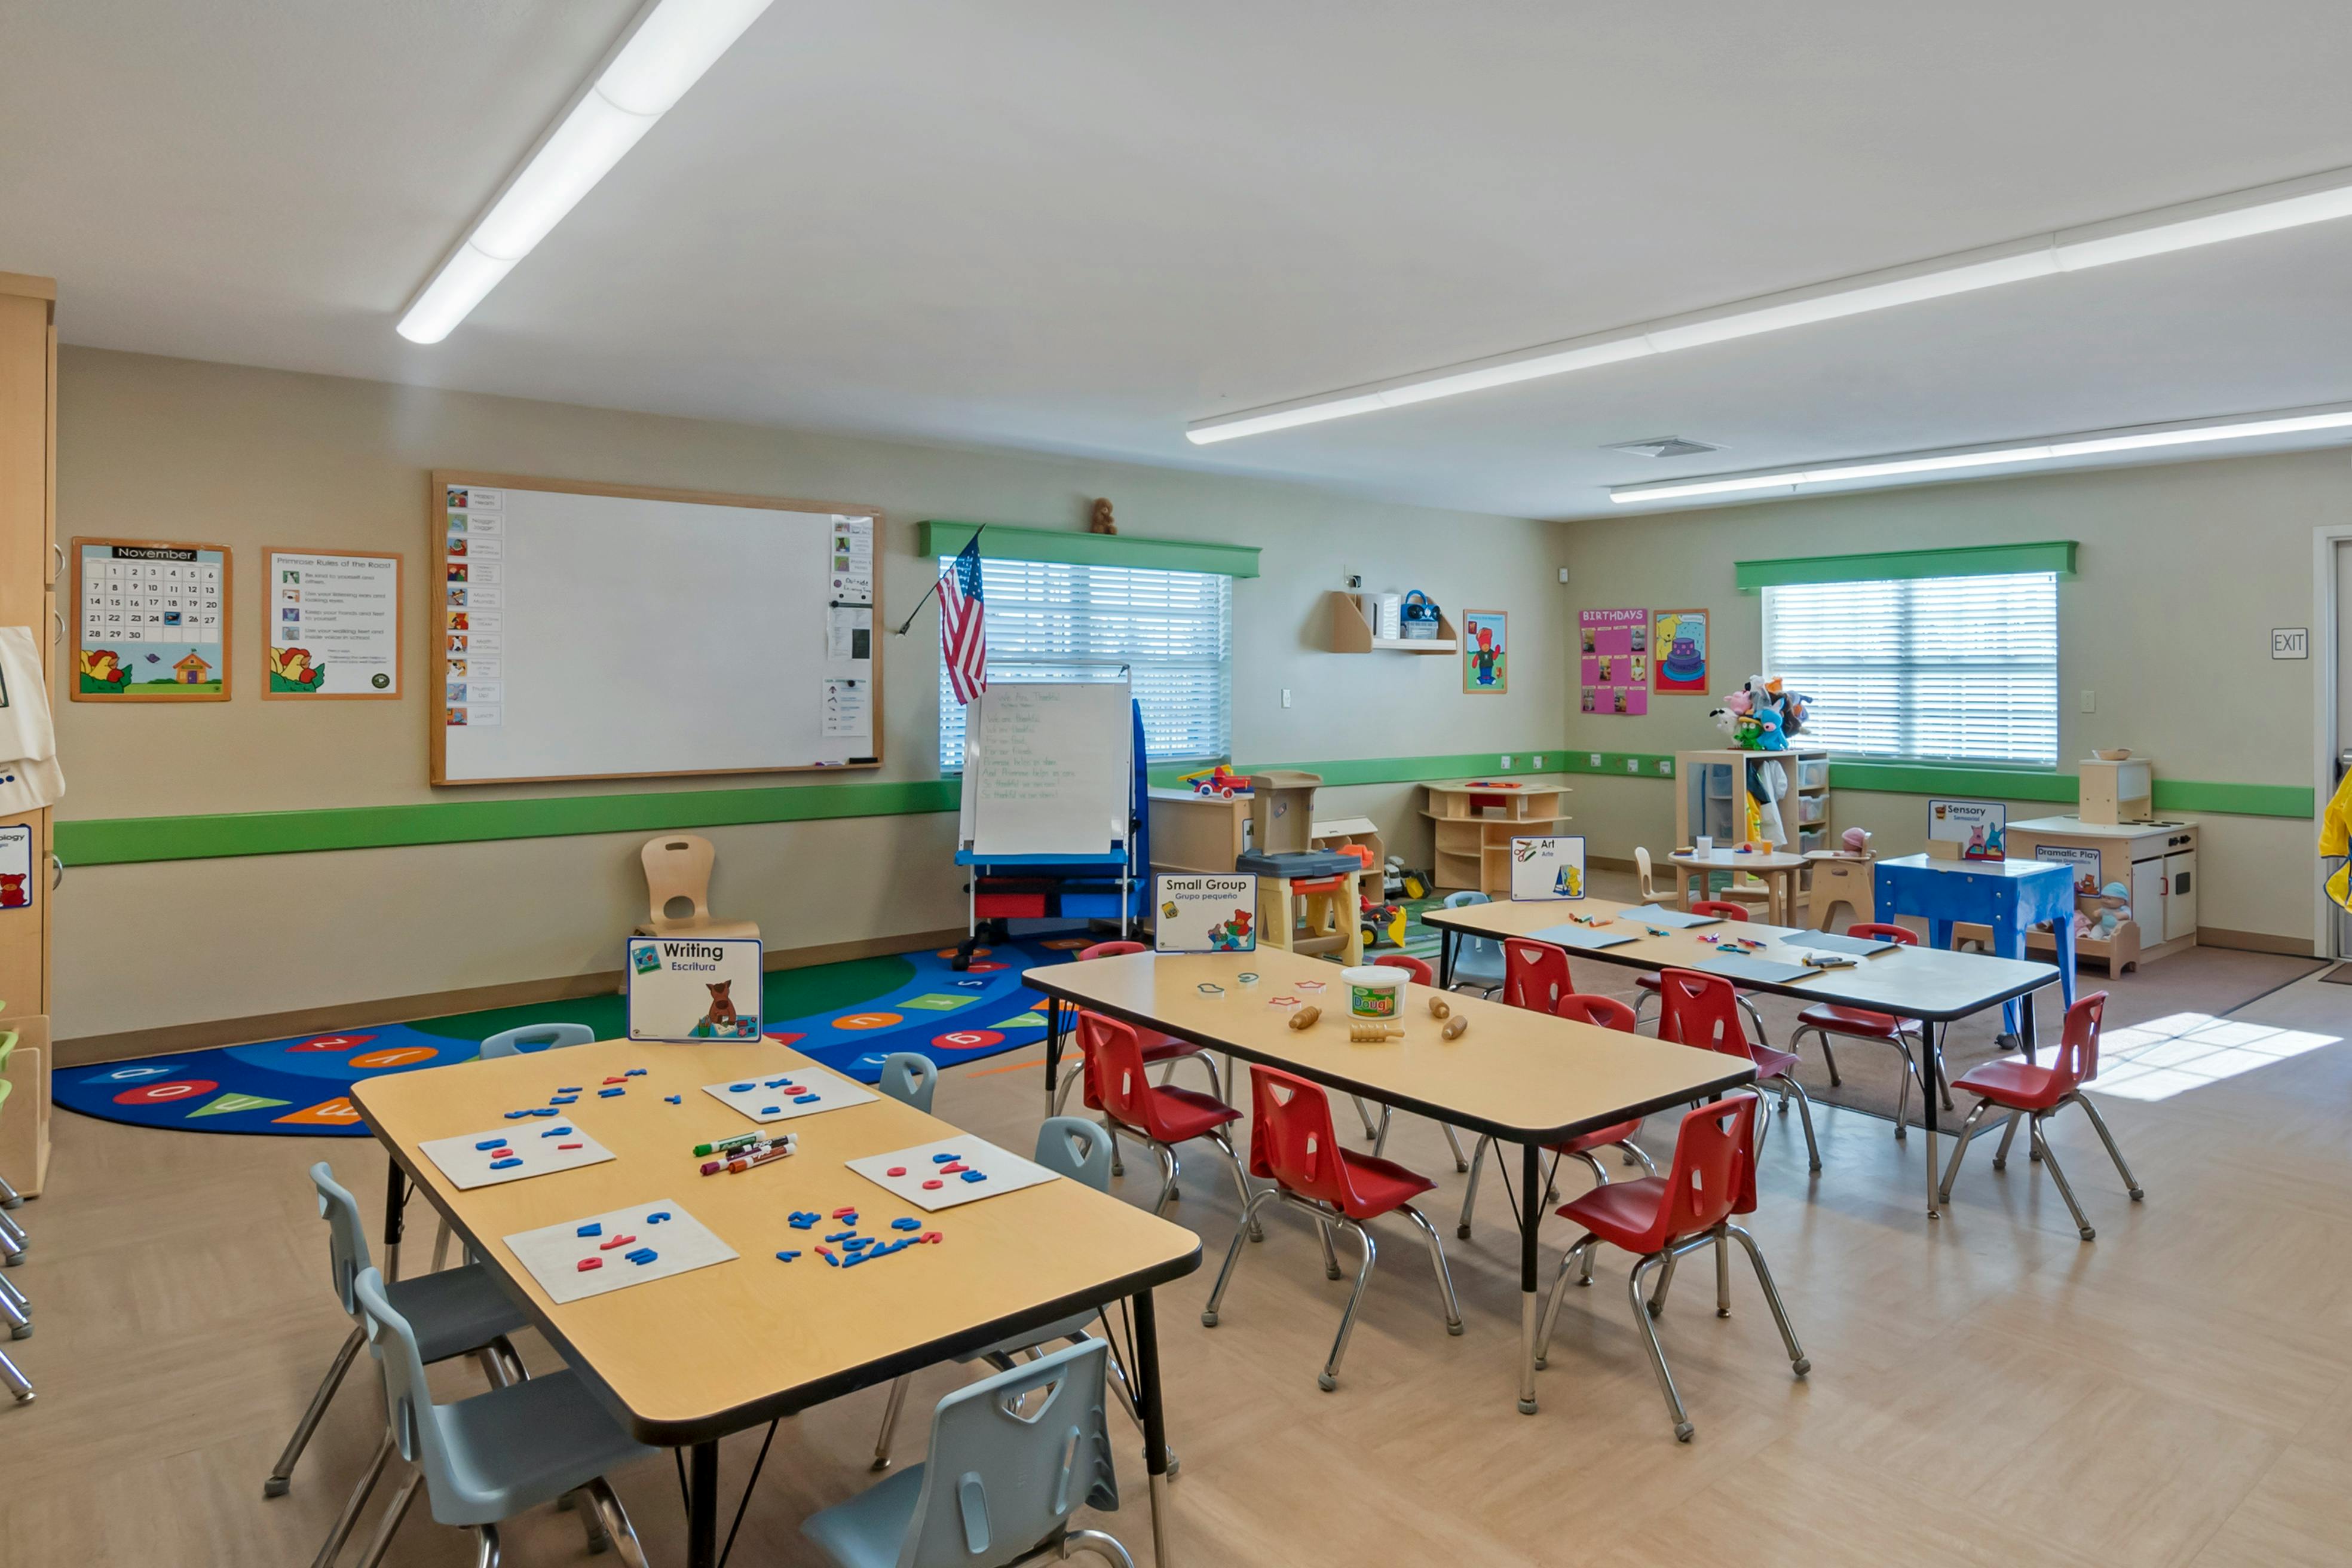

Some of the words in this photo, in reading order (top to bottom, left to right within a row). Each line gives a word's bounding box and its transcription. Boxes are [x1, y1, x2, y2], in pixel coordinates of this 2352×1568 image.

[118, 547, 192, 559] November
[1583, 610, 1643, 621] BIRTHDAYS
[2274, 634, 2305, 651] EXIT
[1948, 804, 1986, 817] Sensory
[1541, 840, 1555, 848] Art
[2038, 848, 2077, 858] Dramatic
[2080, 851, 2098, 860] Play
[1166, 879, 1202, 890] Small
[1206, 879, 1247, 892] Group
[1202, 892, 1238, 901] pequeño
[664, 943, 723, 961] Writing
[672, 962, 716, 971] Escritura
[1353, 995, 1394, 1015] Dough
